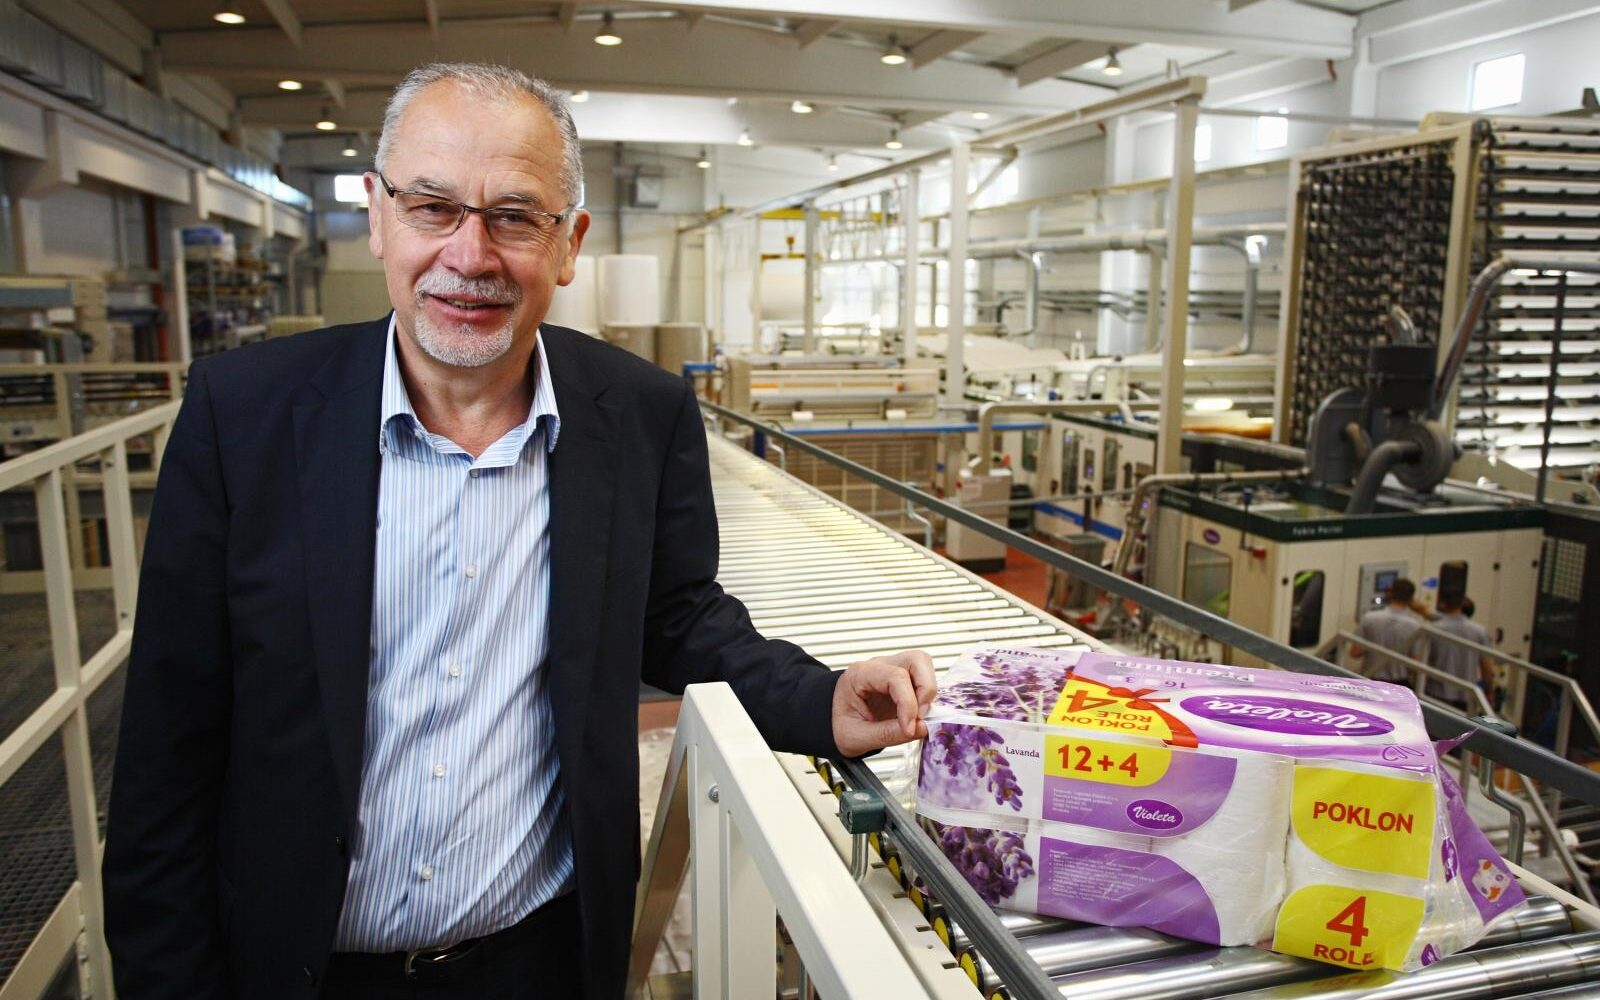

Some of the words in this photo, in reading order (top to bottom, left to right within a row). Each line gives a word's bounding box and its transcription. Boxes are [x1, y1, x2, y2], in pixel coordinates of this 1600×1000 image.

[1114, 661, 1255, 683] Premium
[1066, 689, 1118, 713] 4
[1061, 715, 1150, 731] POKLON
[1097, 710, 1153, 723] ROLE
[1202, 698, 1370, 729] Violeta
[1005, 746, 1040, 758] Lavanda
[1057, 744, 1139, 778] 12+4
[1132, 806, 1176, 823] Violeta
[1312, 801, 1414, 834] POKLON
[1326, 896, 1369, 947] 4
